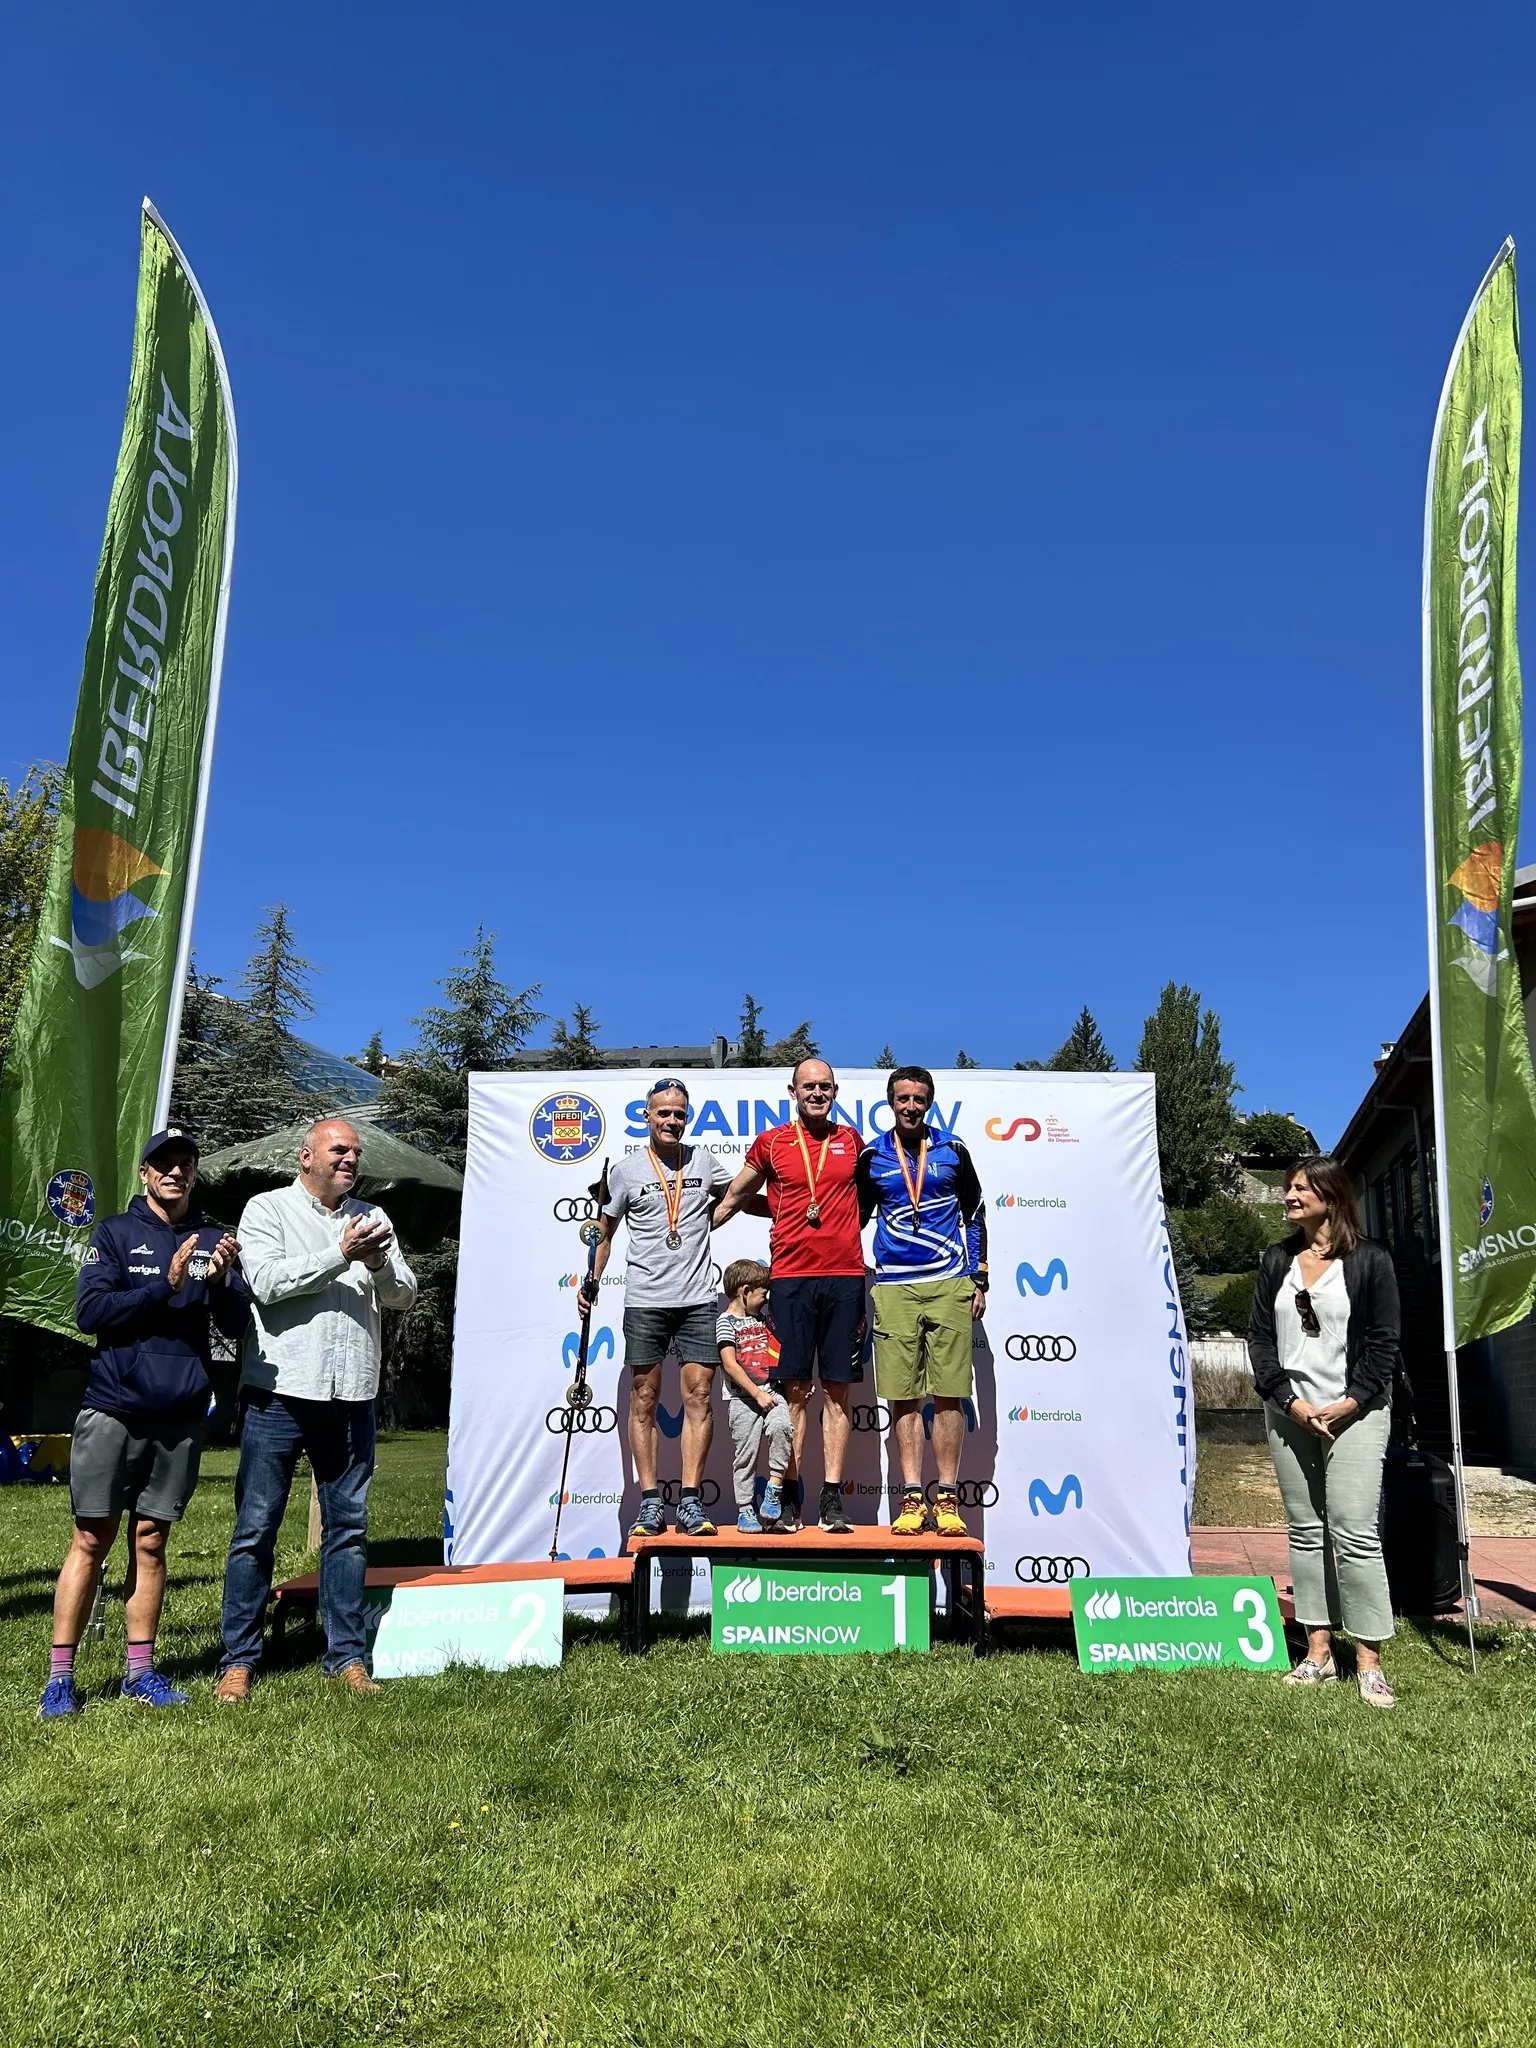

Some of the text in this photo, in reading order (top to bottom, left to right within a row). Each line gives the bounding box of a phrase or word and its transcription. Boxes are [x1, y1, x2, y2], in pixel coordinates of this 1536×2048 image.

[1458, 402, 1497, 832] IBERDROLA
[554, 1112, 580, 1120] RFEDI
[624, 1099, 962, 1138] SAINNOW
[684, 1179, 700, 1187] SKI
[1017, 1197, 1067, 1208] Iberdrola
[1031, 1409, 1081, 1421] Iberdrola
[571, 1492, 623, 1504] Iberdrola
[653, 1565, 706, 1577] Iberdrola
[766, 1575, 906, 1646] Iberdrola 1
[397, 1591, 547, 1664] Iberdrola 2
[721, 1625, 861, 1645] SPAINSNOW
[1124, 1588, 1274, 1663] Iberdrola 3
[1088, 1641, 1222, 1663] SPAINSNOW
